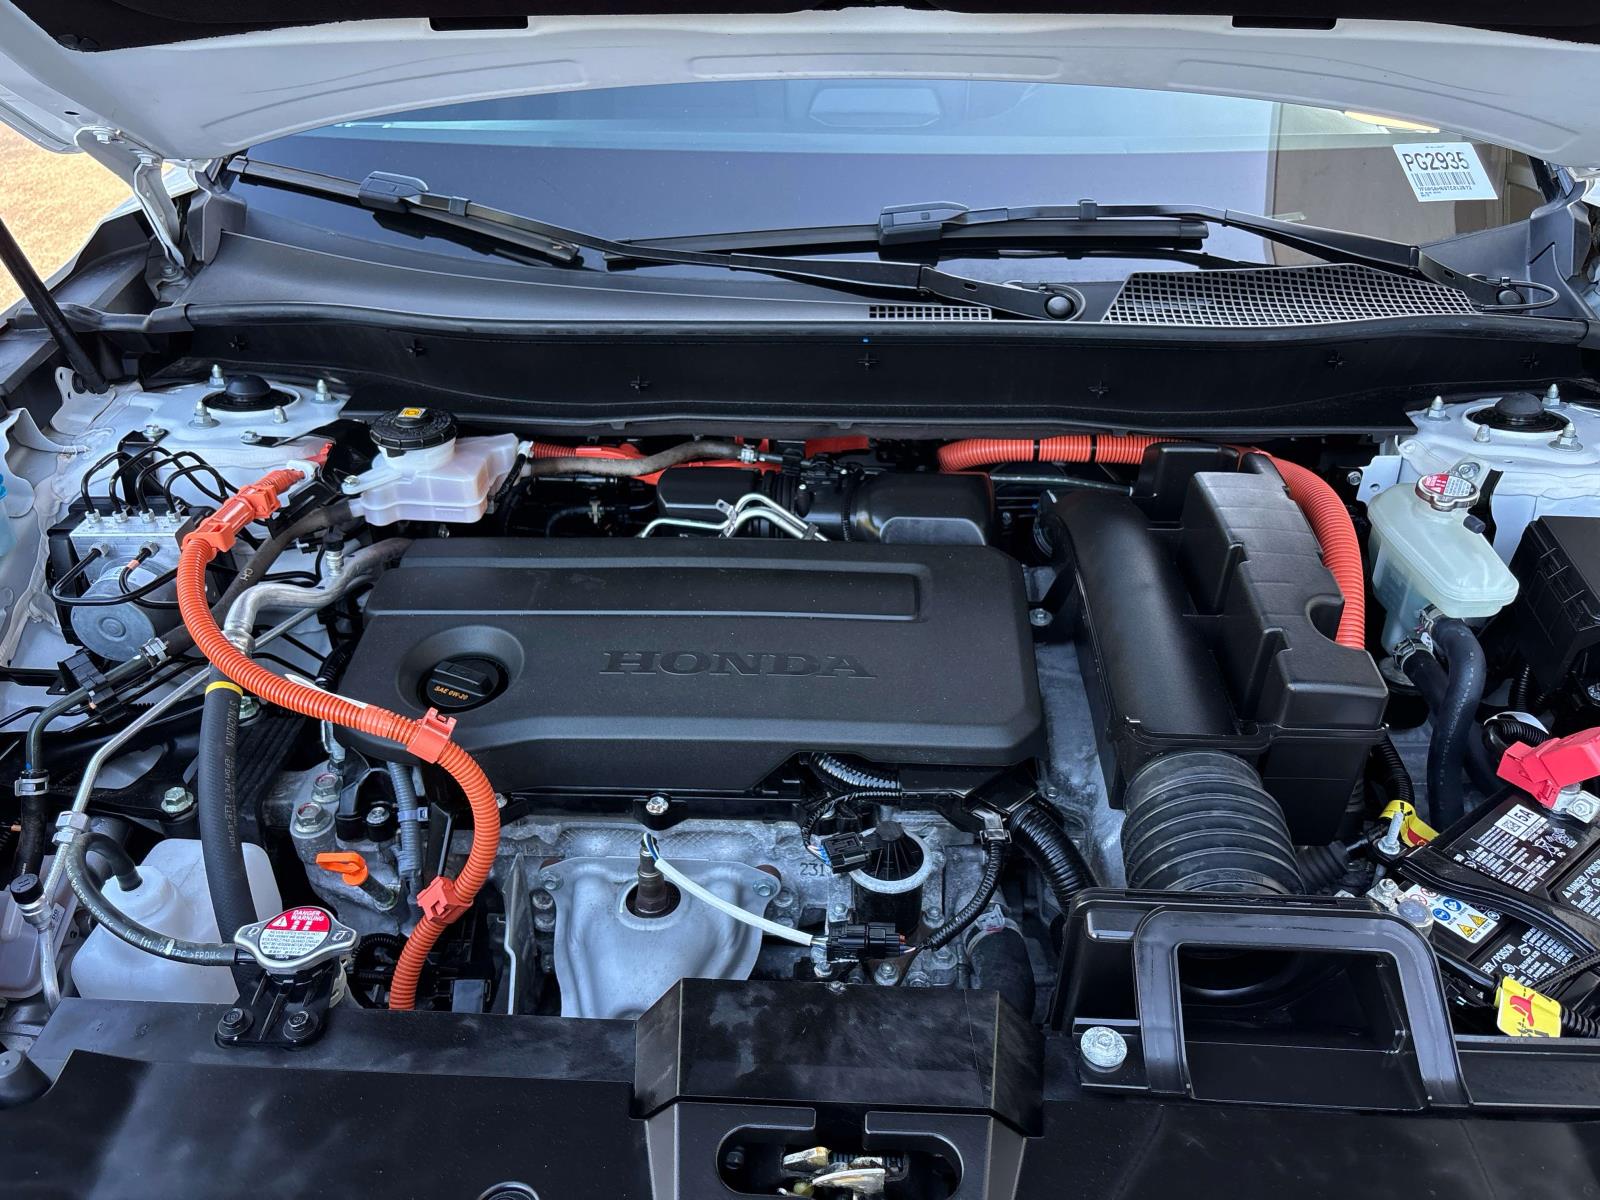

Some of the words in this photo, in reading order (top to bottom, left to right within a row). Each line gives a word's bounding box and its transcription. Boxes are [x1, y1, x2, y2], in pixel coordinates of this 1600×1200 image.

[1402, 151, 1470, 172] PG2935
[599, 651, 878, 679] HONDA
[433, 685, 449, 694] SAE
[448, 690, 469, 701] 0W-20
[1514, 808, 1535, 821] 5A
[800, 862, 825, 877] 231
